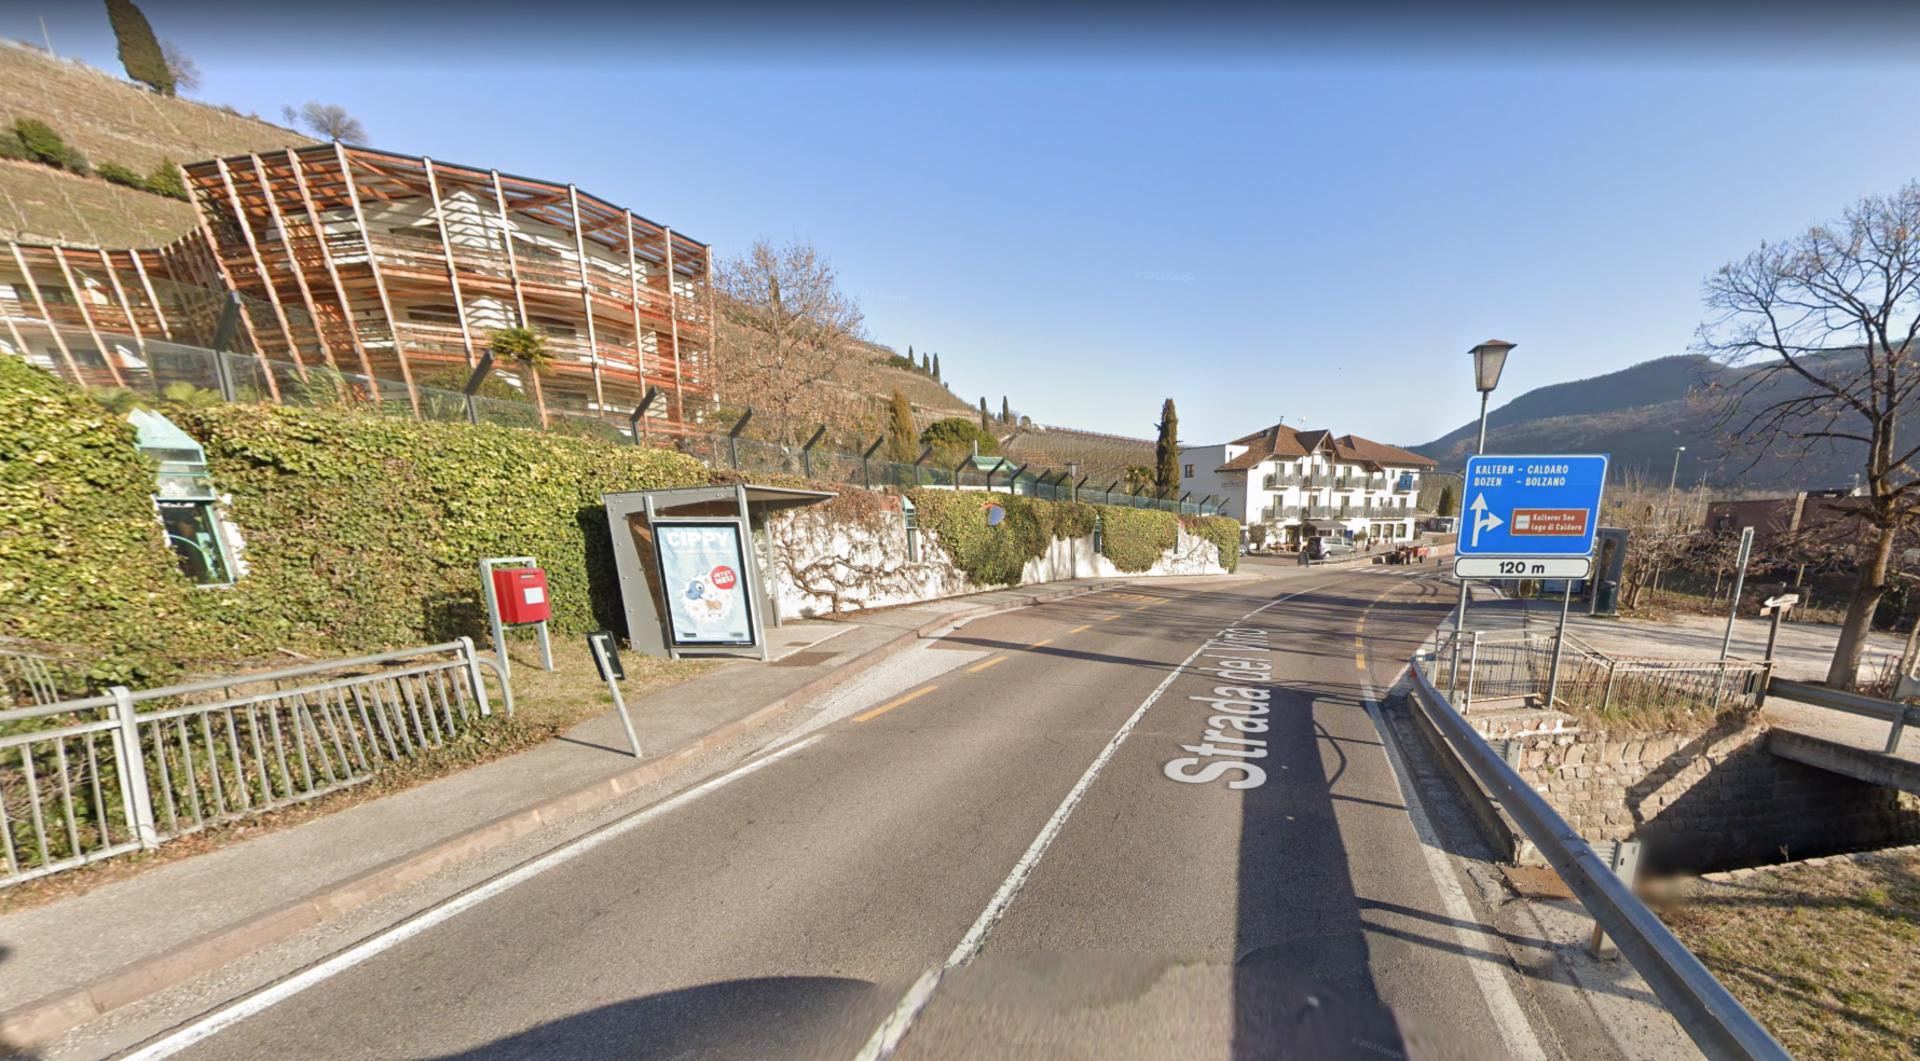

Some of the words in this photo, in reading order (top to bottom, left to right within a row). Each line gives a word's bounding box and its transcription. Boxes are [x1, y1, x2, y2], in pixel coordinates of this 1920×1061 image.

[1475, 464, 1514, 475] KALTERN
[1527, 464, 1569, 475] CALDARO
[1474, 477, 1502, 487] BOZEN
[1525, 477, 1566, 487] BOLZANO
[1532, 513, 1561, 521] Kalterer
[1563, 513, 1576, 521] See
[1555, 523, 1582, 531] Caldaro
[666, 531, 730, 548] CIPPY
[1499, 561, 1526, 574] 120
[1531, 564, 1545, 574] m
[715, 575, 735, 585] NEU
